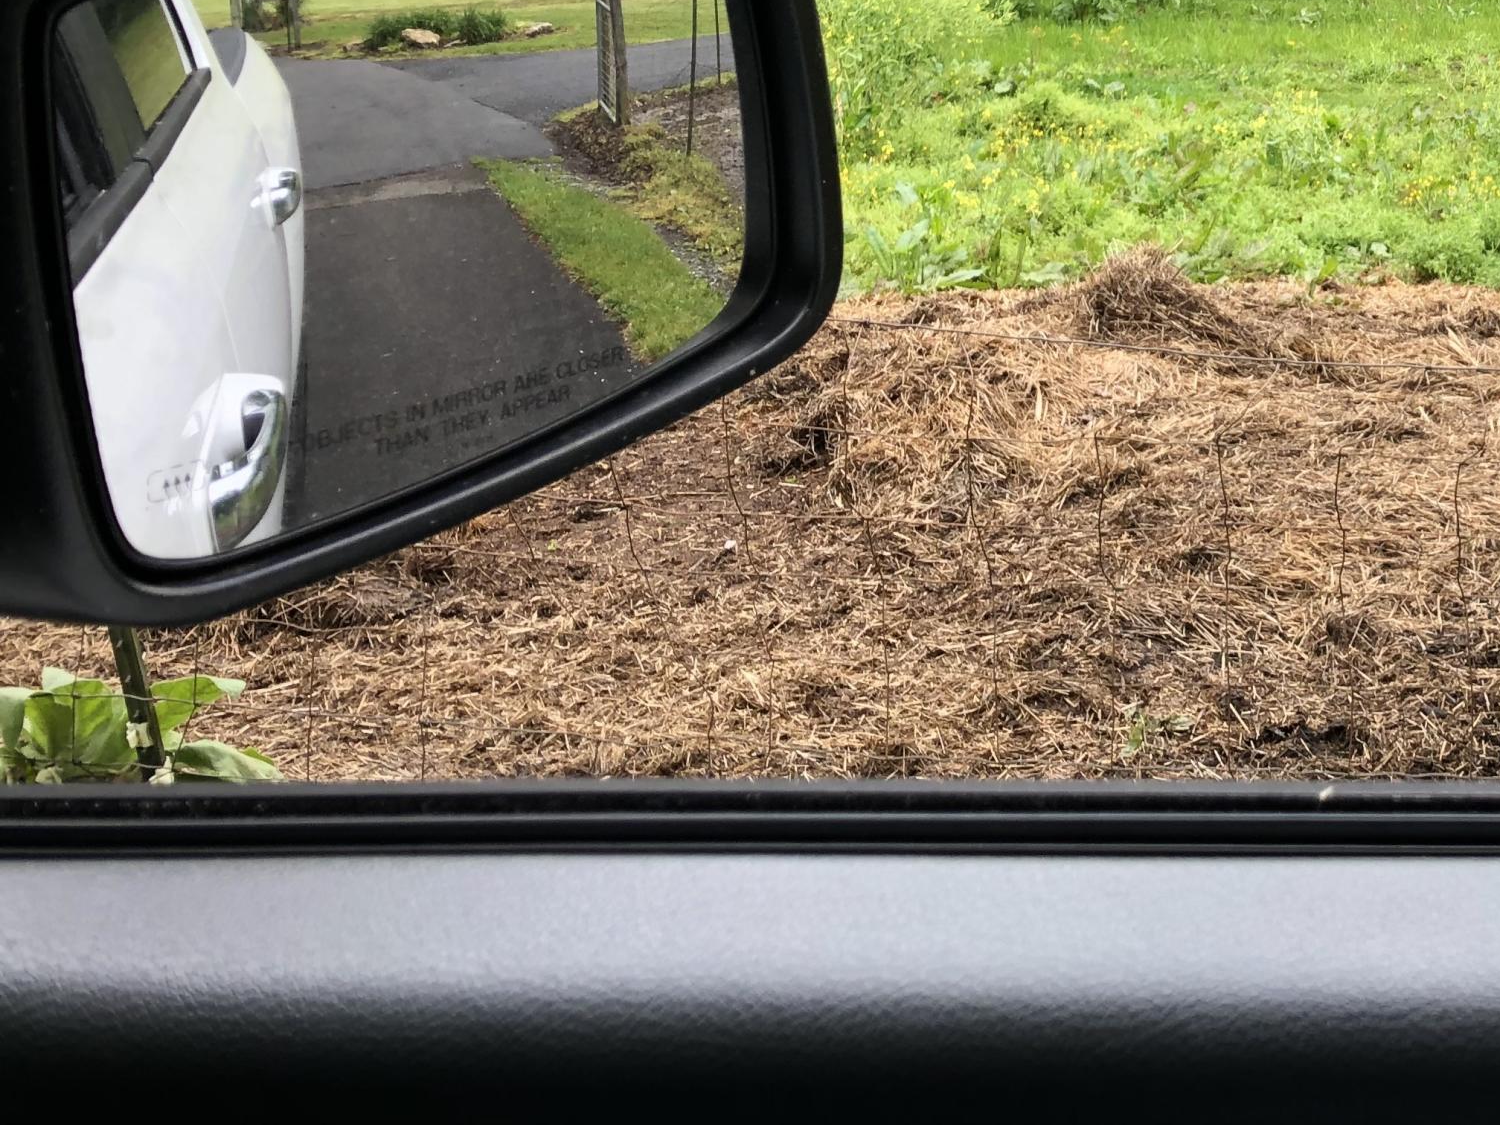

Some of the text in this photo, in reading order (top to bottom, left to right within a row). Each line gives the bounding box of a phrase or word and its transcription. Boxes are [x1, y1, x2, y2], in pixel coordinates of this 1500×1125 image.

[374, 425, 431, 456] THAN
[441, 410, 488, 436] THEY
[500, 384, 572, 420] APPEAR
[405, 401, 427, 423] IN
[432, 379, 507, 416] MIRROR
[513, 367, 550, 394] ARE
[556, 345, 625, 380] CLOSER
